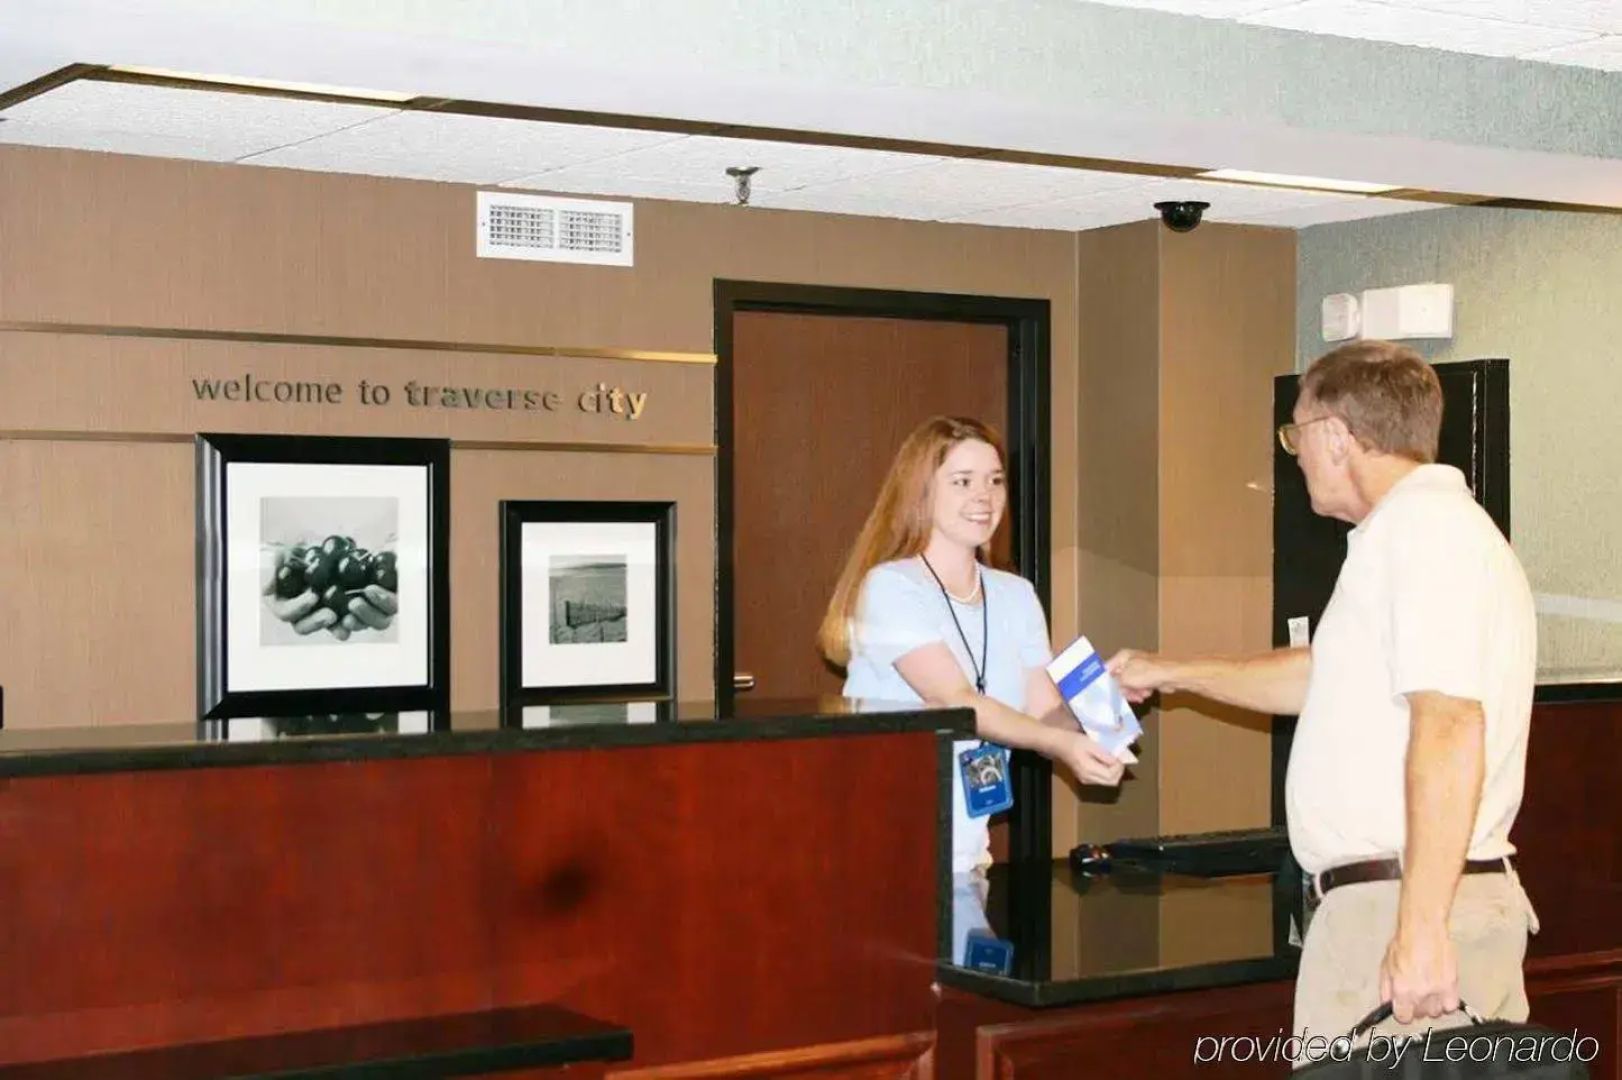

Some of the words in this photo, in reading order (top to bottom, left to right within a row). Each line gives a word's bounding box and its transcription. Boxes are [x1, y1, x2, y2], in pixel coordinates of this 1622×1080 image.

[192, 373, 343, 404] welcome
[358, 379, 391, 405] to
[404, 380, 563, 412] traverse
[578, 381, 648, 421] city
